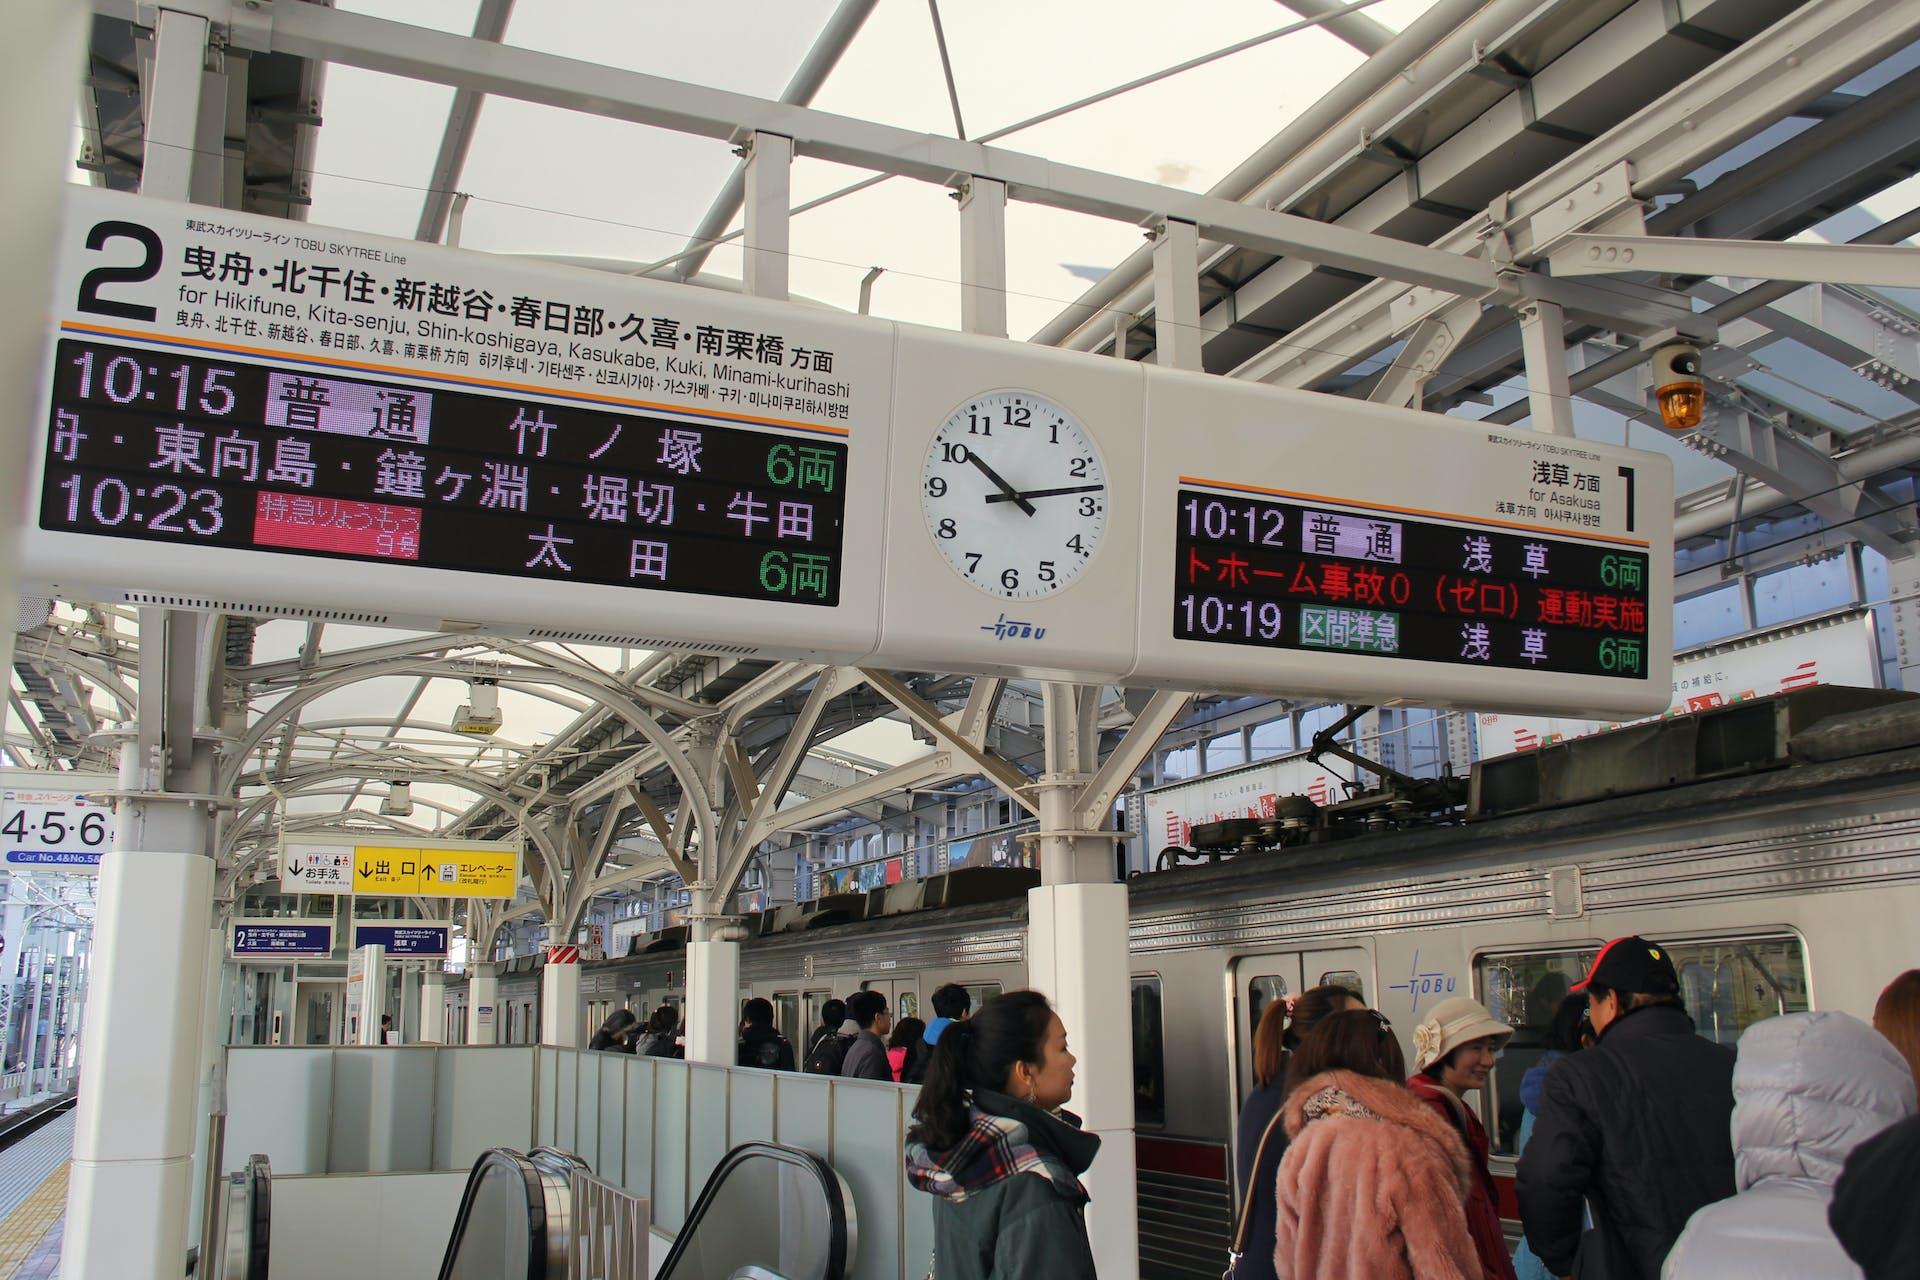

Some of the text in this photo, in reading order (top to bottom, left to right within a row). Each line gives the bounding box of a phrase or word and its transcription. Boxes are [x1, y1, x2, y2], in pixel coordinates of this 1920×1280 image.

[186, 219, 406, 266] 東武スカイツリーライン TOBU SKYTREE Line
[77, 219, 163, 323] 2
[178, 285, 850, 398] for Hikifune, Kita-senju, Shin-koshigaya, Kasukabe, Kuki, Minami-kurihashi
[790, 347, 834, 374] 方面
[72, 351, 236, 416] 10:15
[278, 378, 420, 443] 普通
[1003, 406, 1031, 428] 12
[968, 414, 992, 437] 11
[1049, 424, 1059, 444] 1
[941, 442, 969, 464] 10
[766, 443, 837, 493] 6両
[1069, 457, 1087, 478] 2
[1532, 459, 1600, 493] 浅草 方面
[928, 477, 948, 497] 9
[1529, 487, 1600, 510] for Asakusa
[60, 474, 224, 536] 10:23
[1078, 497, 1095, 517] 3
[1618, 466, 1635, 532] 1
[260, 493, 420, 535] 特急りょうもう
[1185, 499, 1285, 546] 10:12
[937, 518, 957, 539] 8
[1309, 514, 1395, 562] 普通
[376, 534, 417, 557] 9号
[526, 524, 669, 580] 太田
[1066, 534, 1084, 554] 4
[965, 552, 982, 573] 7
[1462, 536, 1549, 579] 浅草
[759, 551, 831, 598] 6両
[1001, 569, 1019, 589] 6
[1038, 561, 1056, 581] 5
[1600, 554, 1642, 592] 6両
[1181, 594, 1282, 640] 10:19
[990, 619, 1046, 641] TOBU
[1301, 608, 1399, 652] 区間準急
[1460, 622, 1548, 665] 浅草
[1599, 636, 1641, 674] 6両
[17, 852, 36, 862] Car
[376, 860, 415, 876] 出口
[305, 868, 340, 880] お手洗
[460, 864, 513, 874] エレベーター
[237, 931, 246, 948] 2
[438, 933, 444, 949] 1
[1408, 977, 1456, 996] TOBU
